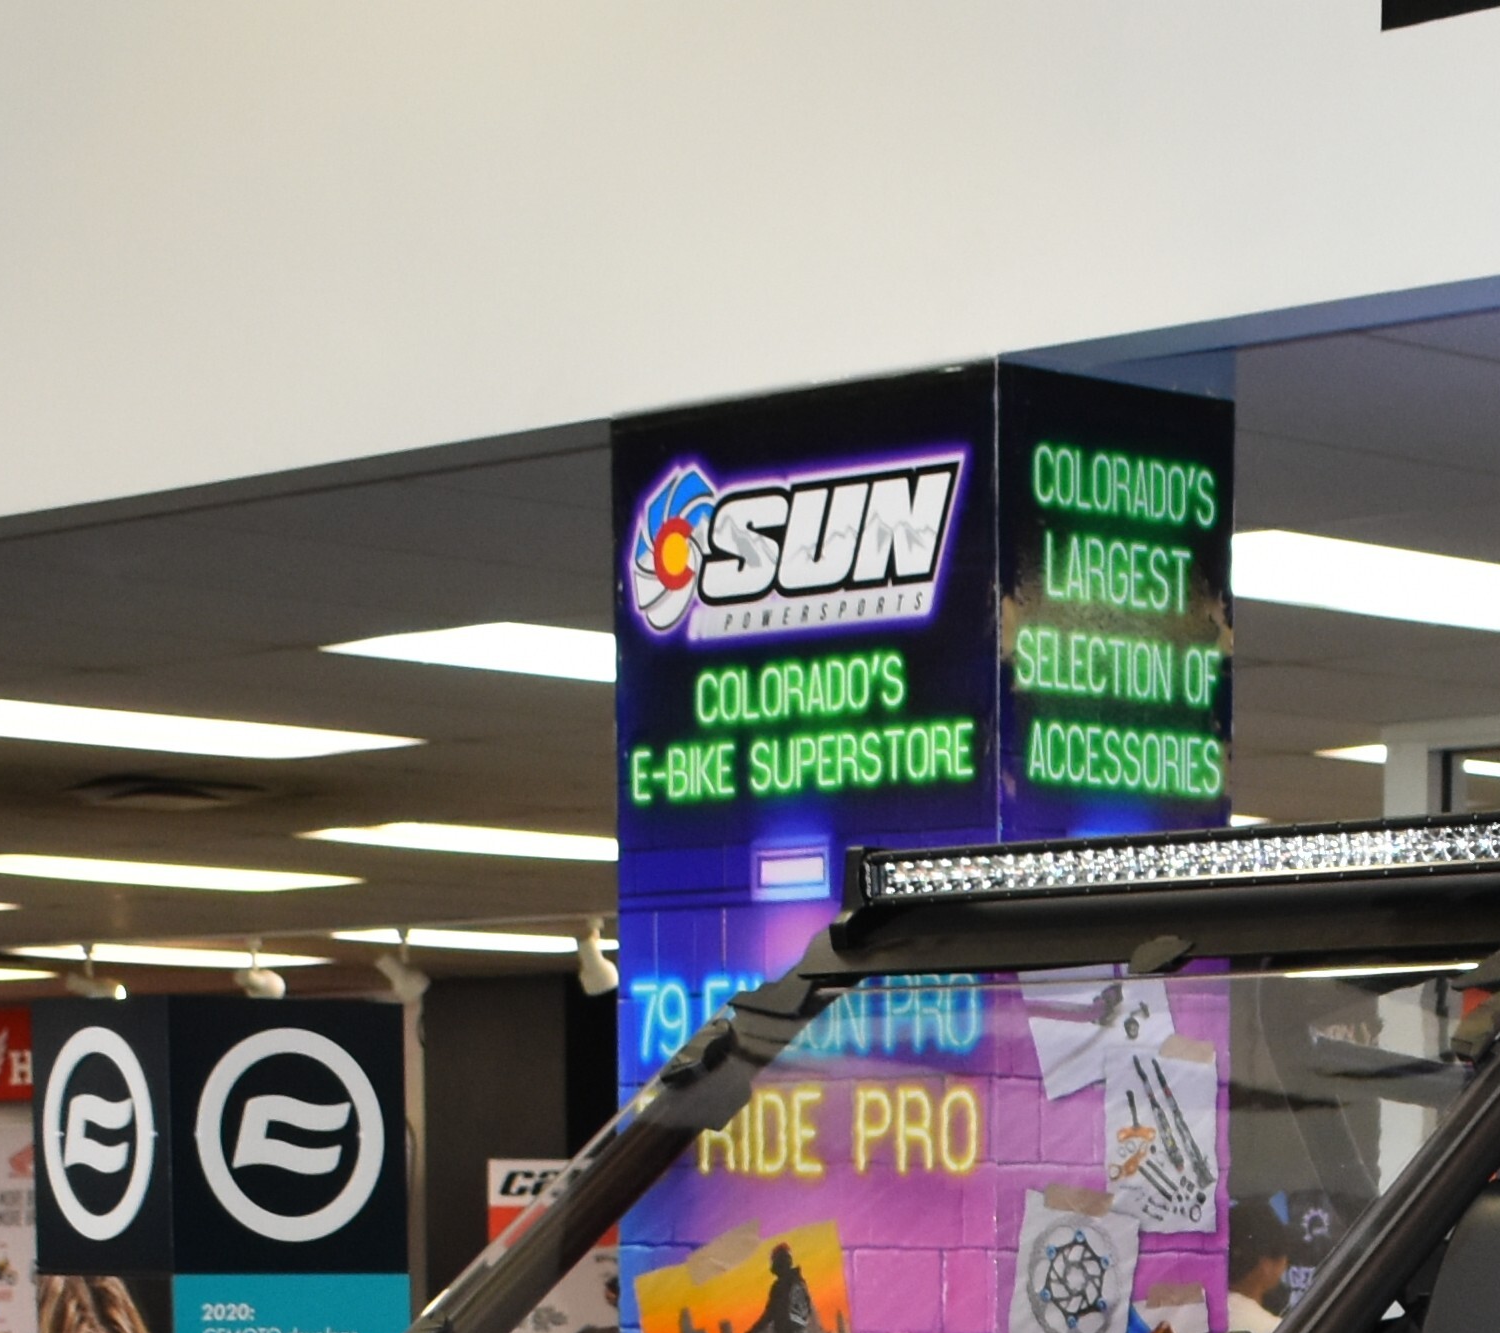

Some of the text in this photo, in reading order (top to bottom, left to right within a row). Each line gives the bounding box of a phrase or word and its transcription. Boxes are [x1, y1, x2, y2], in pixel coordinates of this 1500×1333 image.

[1033, 444, 1216, 528] COLORADO'S
[702, 466, 958, 602] SUN
[1045, 530, 1191, 613] LARGEST
[725, 590, 924, 632] POWERSPORTS
[697, 655, 905, 724] COLORADO'S
[1017, 629, 1220, 706] SELECTION OF
[633, 720, 975, 801] E-BIKE SUPERSTORE
[1029, 721, 1221, 797] ACCESSORIES
[632, 981, 688, 1059] 79
[885, 973, 977, 1052] PRO
[702, 1089, 978, 1172] RIDE PRO
[201, 1303, 256, 1321] 2020:
